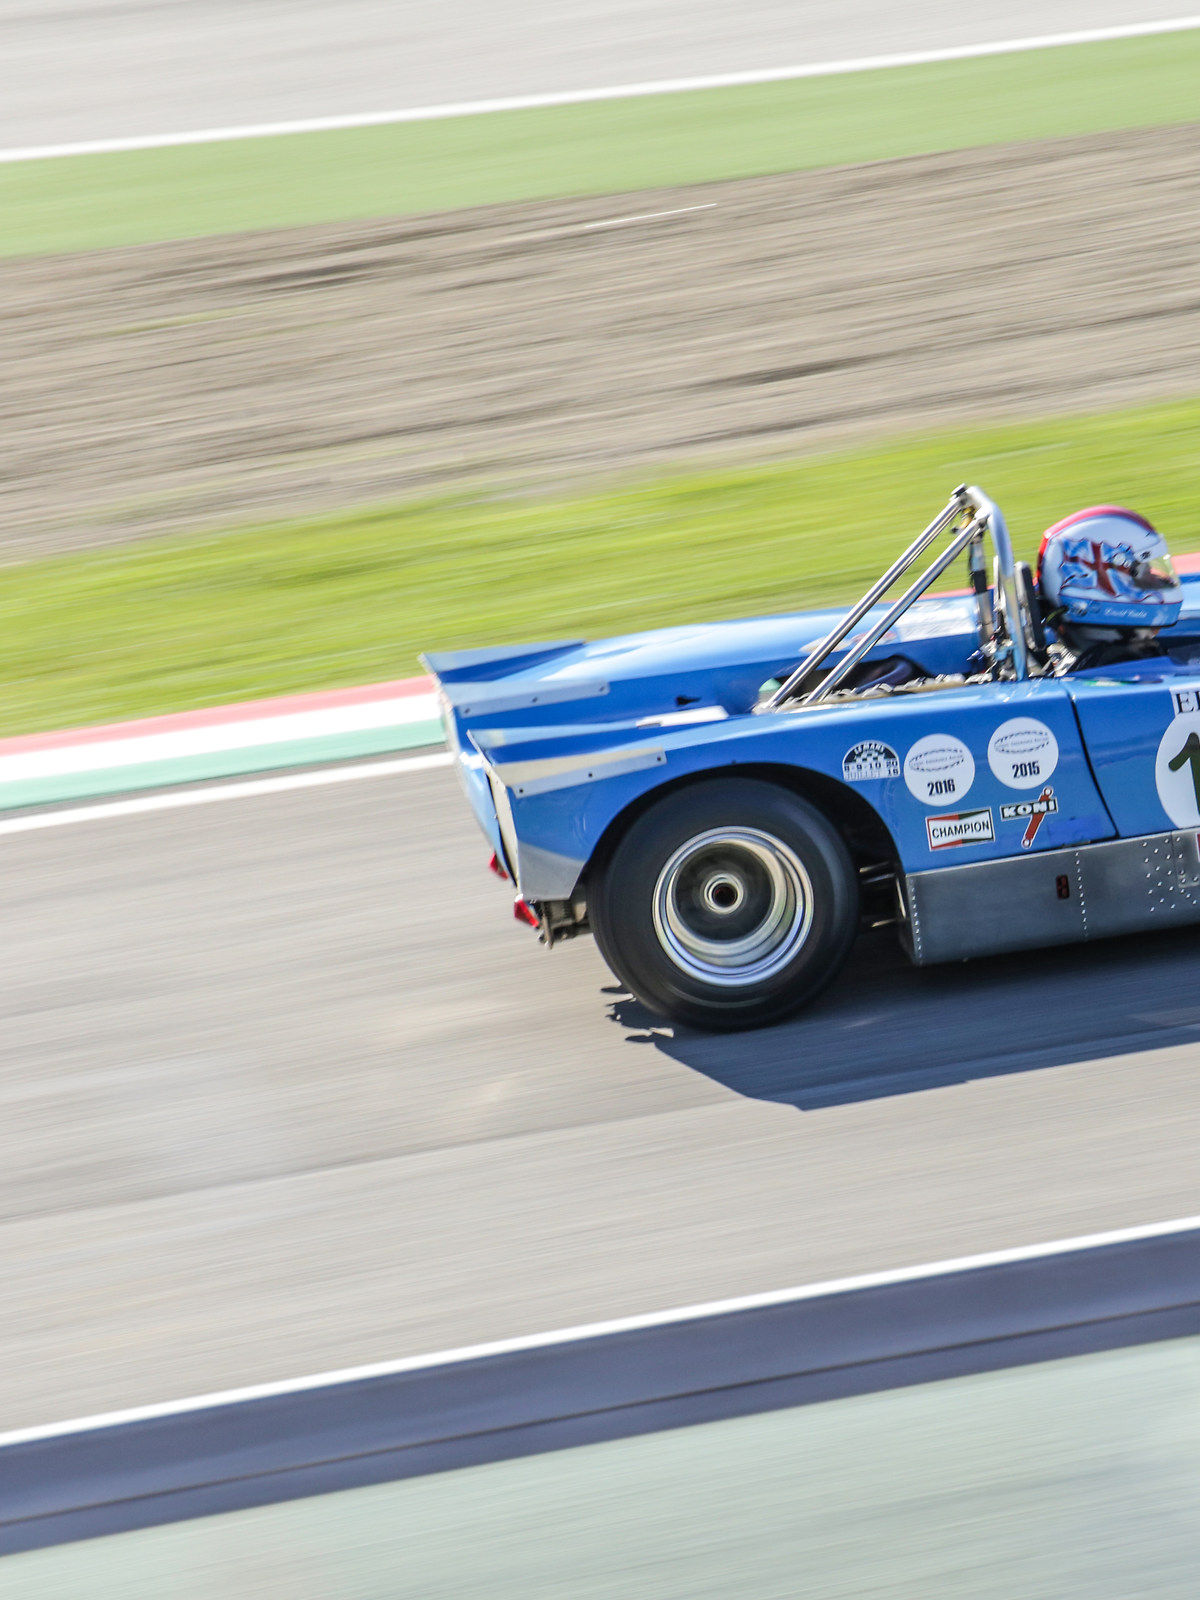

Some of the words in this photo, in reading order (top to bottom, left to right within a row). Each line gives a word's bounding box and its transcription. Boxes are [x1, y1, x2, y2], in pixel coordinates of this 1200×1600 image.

[1012, 760, 1040, 779] 2015
[927, 779, 956, 797] 2016
[1003, 800, 1055, 818] KONI
[932, 820, 990, 839] CHAMPION
